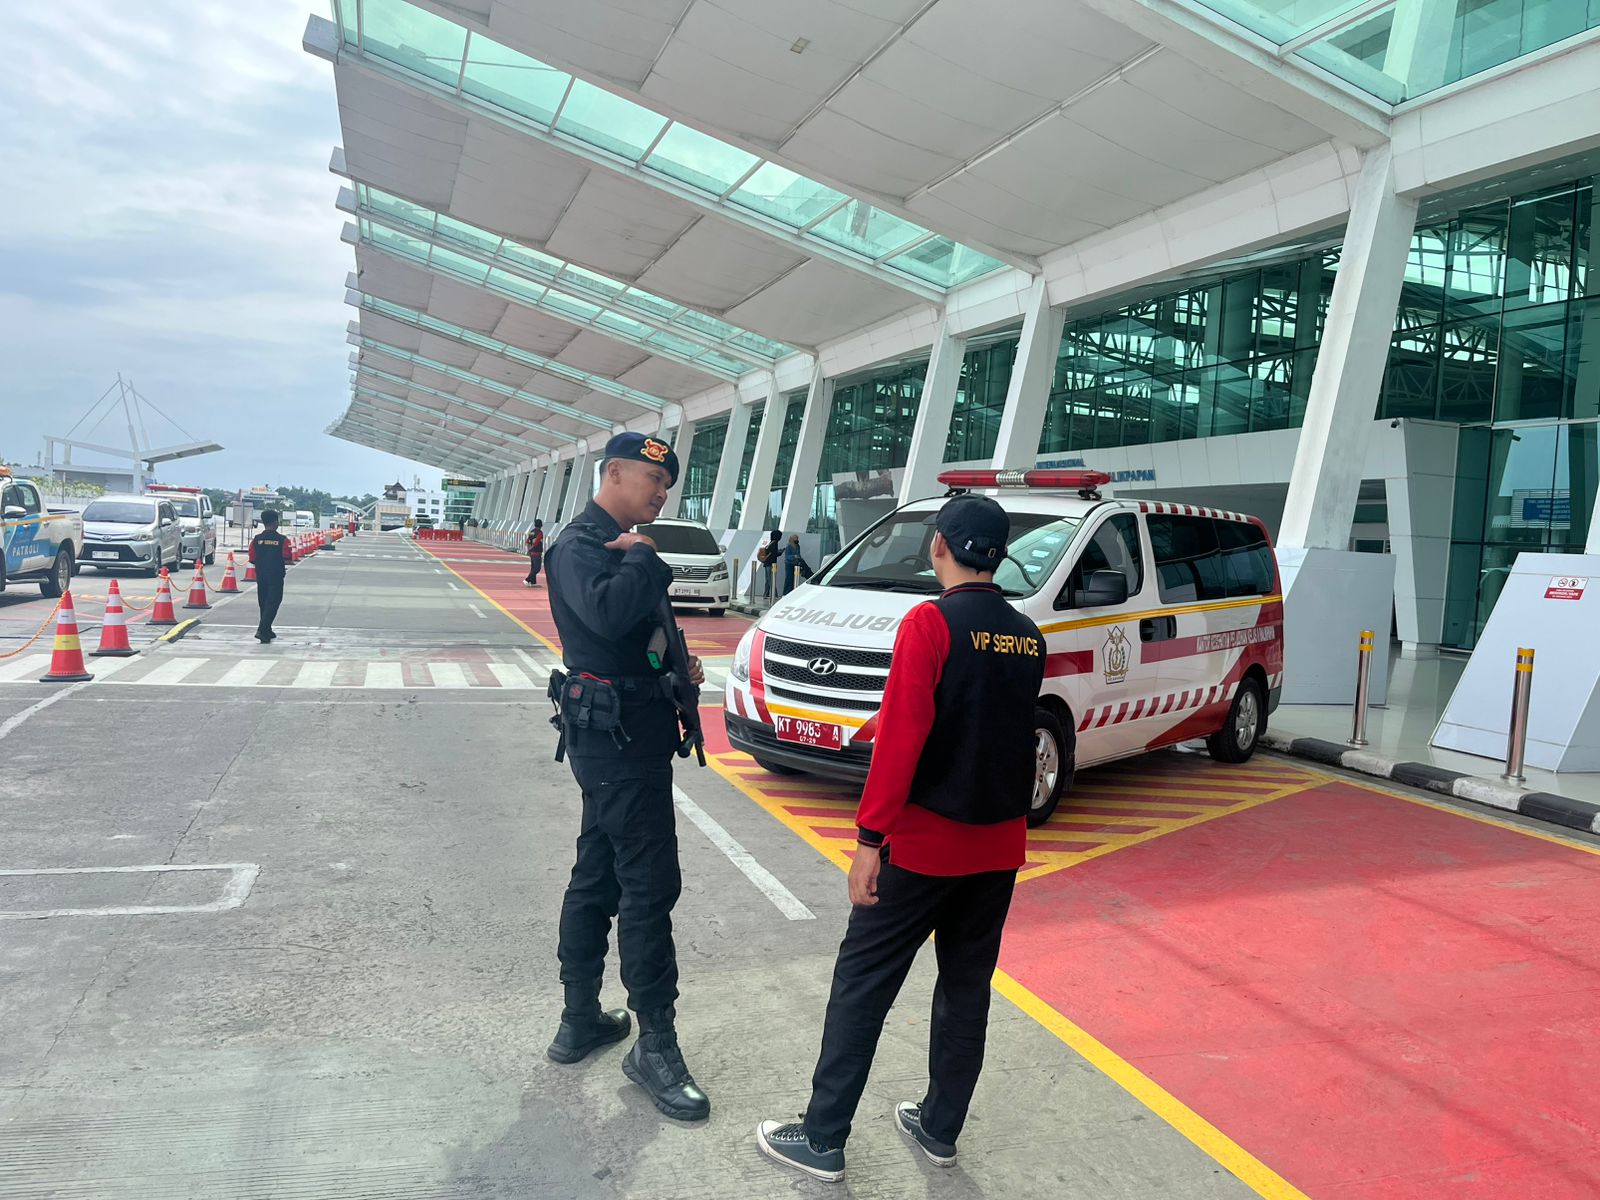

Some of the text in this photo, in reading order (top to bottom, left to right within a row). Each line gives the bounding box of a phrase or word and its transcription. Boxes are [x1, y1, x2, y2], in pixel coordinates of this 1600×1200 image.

[12, 543, 39, 557] PATROLI
[970, 631, 1039, 657] VIP SERVICE
[778, 717, 791, 733] KT
[832, 726, 839, 741] A
